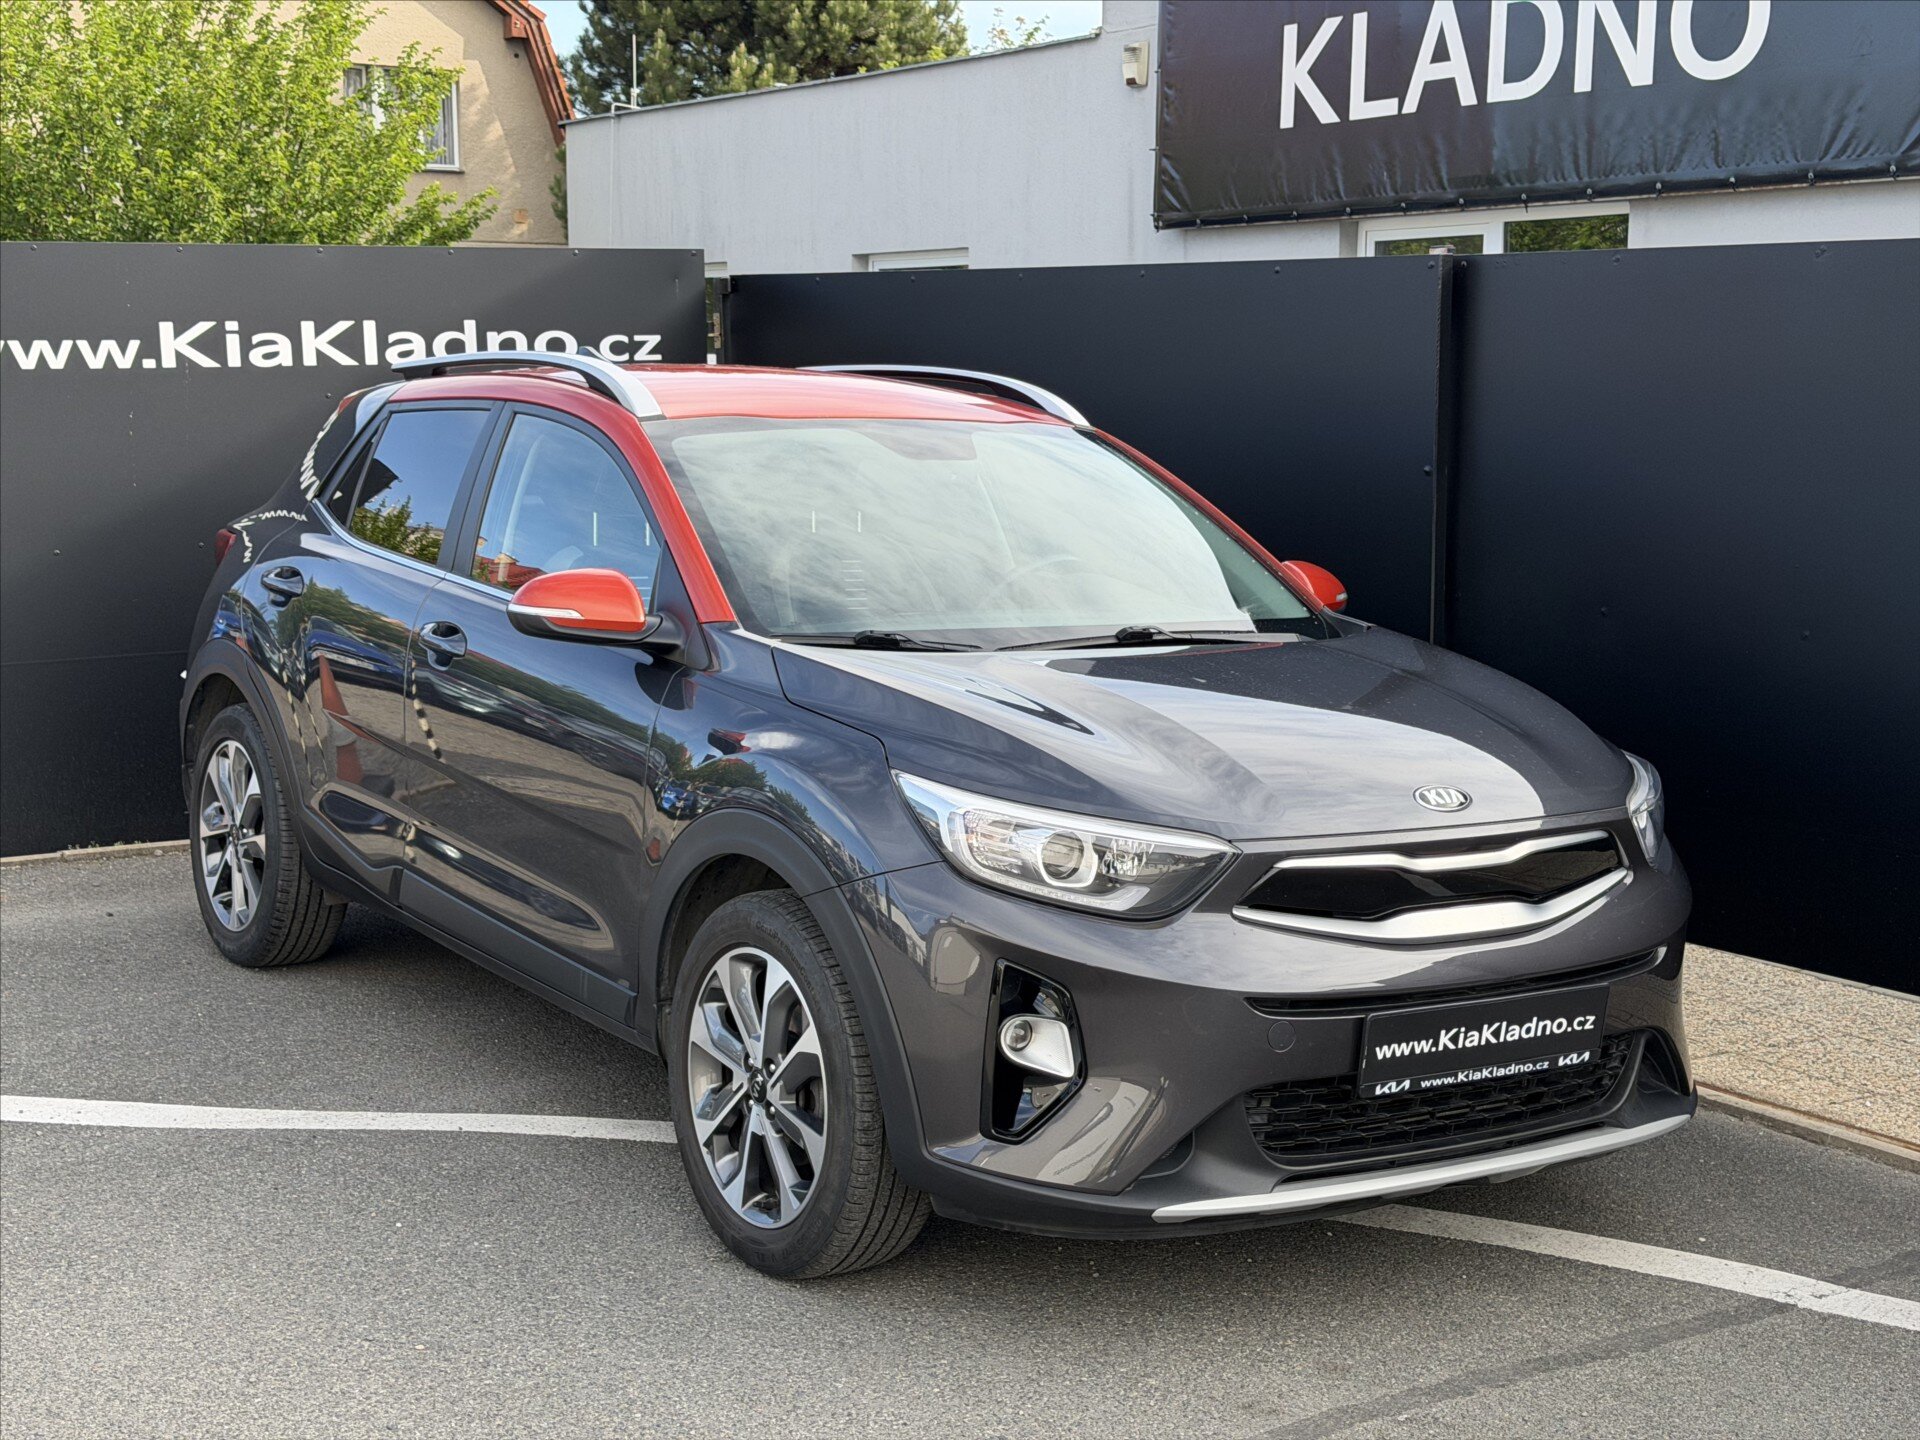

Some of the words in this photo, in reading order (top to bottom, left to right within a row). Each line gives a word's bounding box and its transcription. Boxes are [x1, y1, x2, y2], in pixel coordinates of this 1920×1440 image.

[1280, 0, 1772, 129] KLADNO
[0, 320, 662, 369] ww.KiaKladnocz
[1422, 788, 1466, 805] KIA
[1375, 1015, 1596, 1060] www.KiaKladno.cz
[1420, 1060, 1549, 1088] www.KiaKladno.cz
